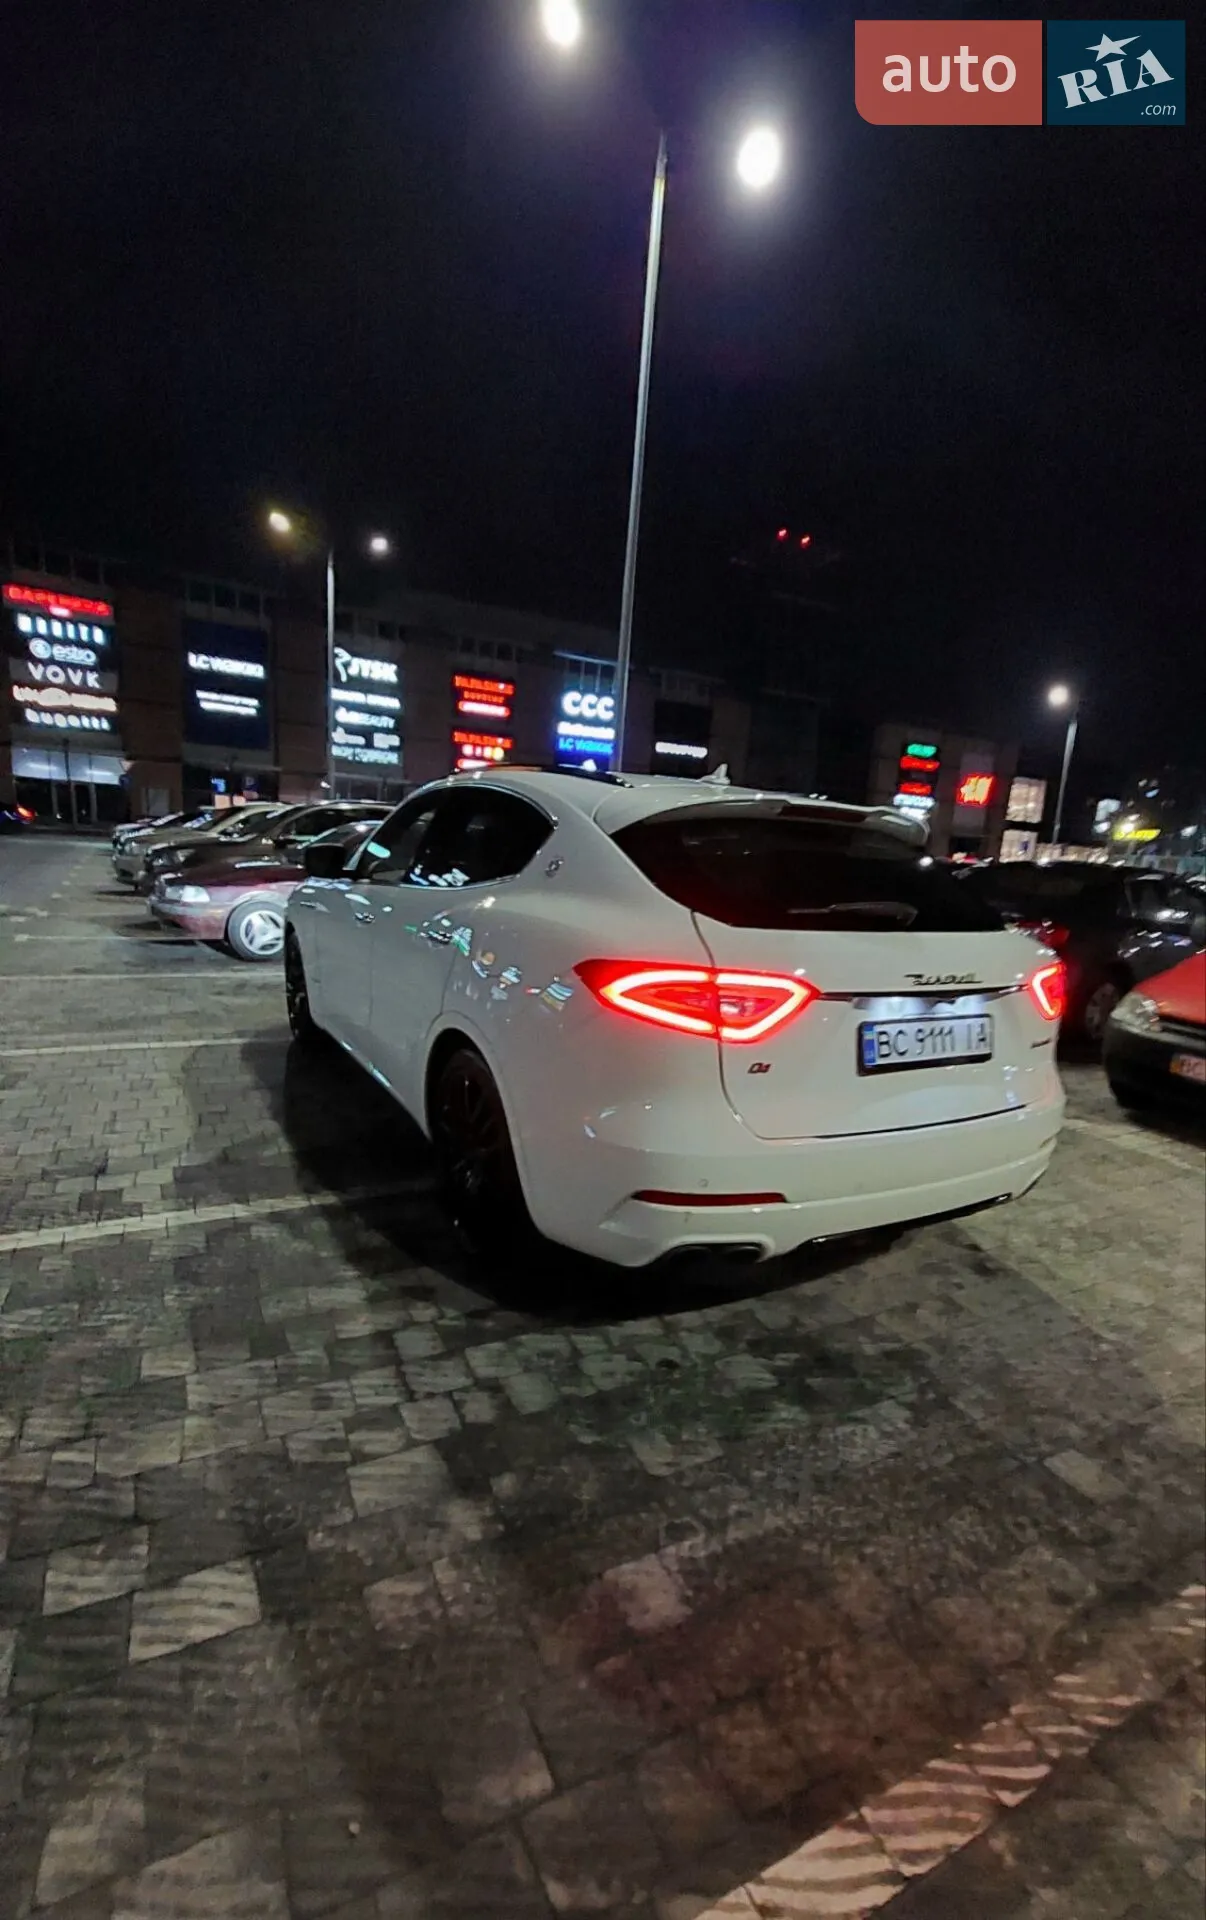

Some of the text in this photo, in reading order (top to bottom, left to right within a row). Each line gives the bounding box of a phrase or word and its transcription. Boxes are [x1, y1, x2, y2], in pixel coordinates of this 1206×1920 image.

[27, 661, 102, 690] VOVK
[561, 690, 615, 721] CCC
[877, 1029, 909, 1059] BC
[915, 1026, 955, 1056] 9111
